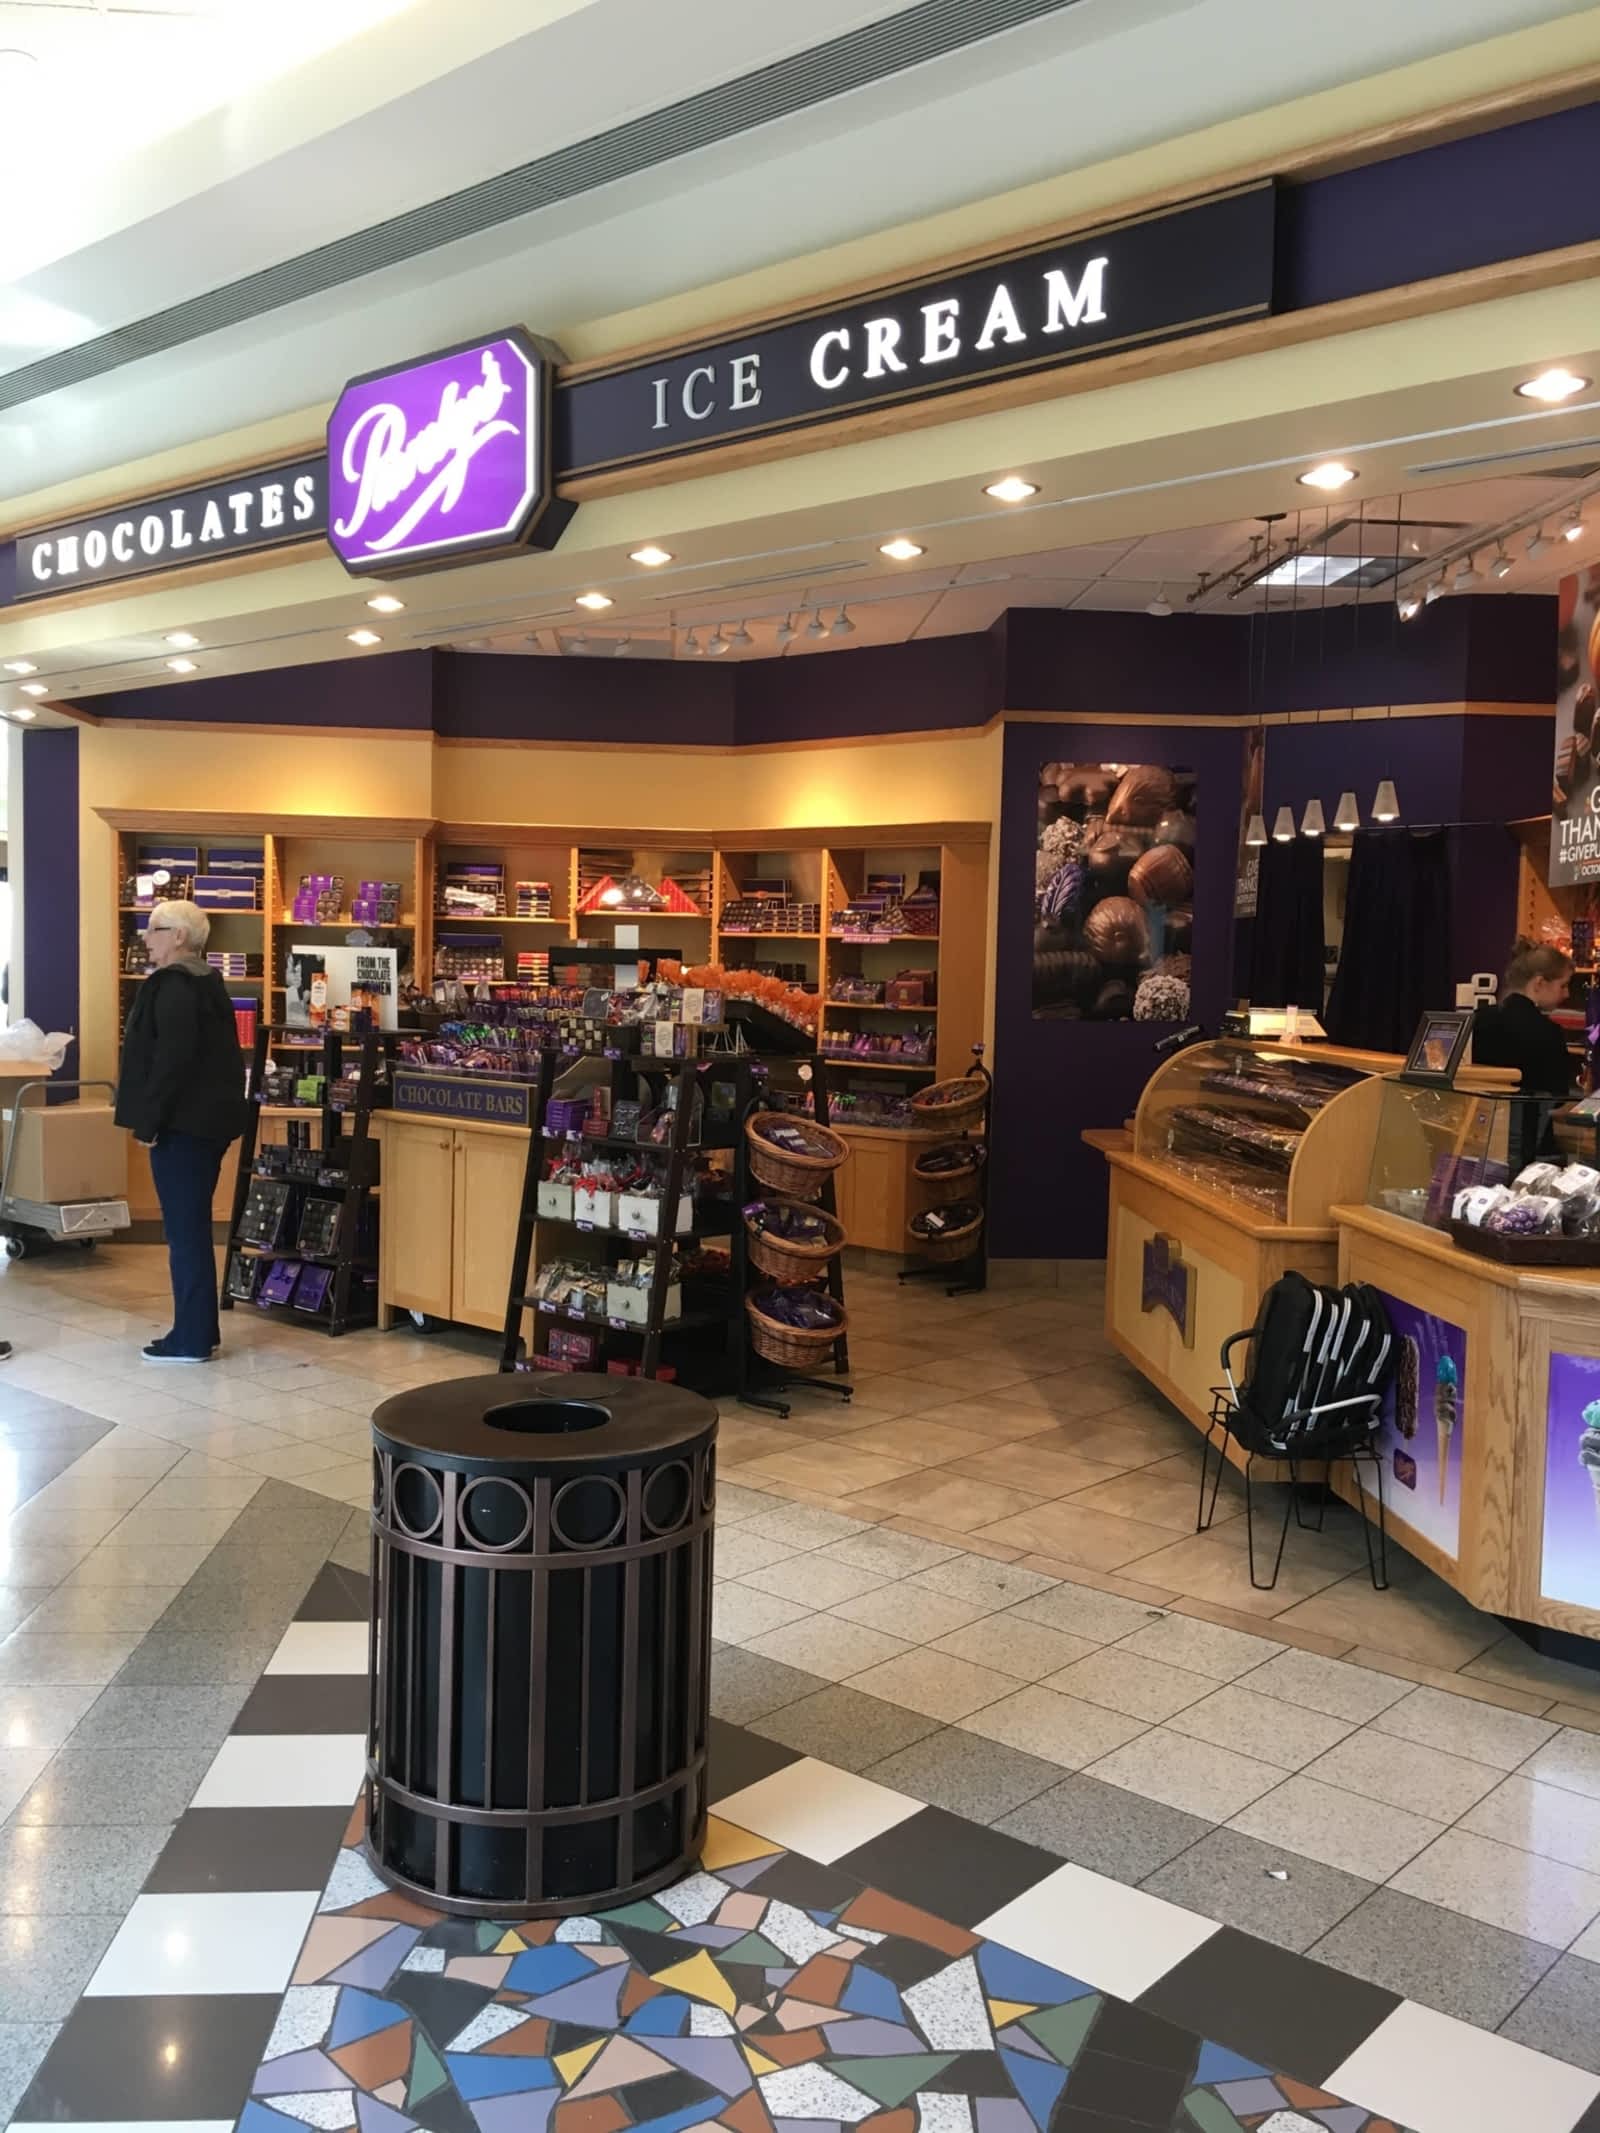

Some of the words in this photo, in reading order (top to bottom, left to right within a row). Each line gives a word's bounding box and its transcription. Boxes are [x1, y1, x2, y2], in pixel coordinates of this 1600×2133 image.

[651, 353, 763, 430] ICE
[809, 256, 1109, 391] CREAM
[30, 475, 315, 581] CHOCOLATES
[356, 955, 376, 969] FROM
[377, 956, 391, 969] THE
[398, 1084, 482, 1111] CHOCOLATE
[485, 1094, 523, 1114] BARS
